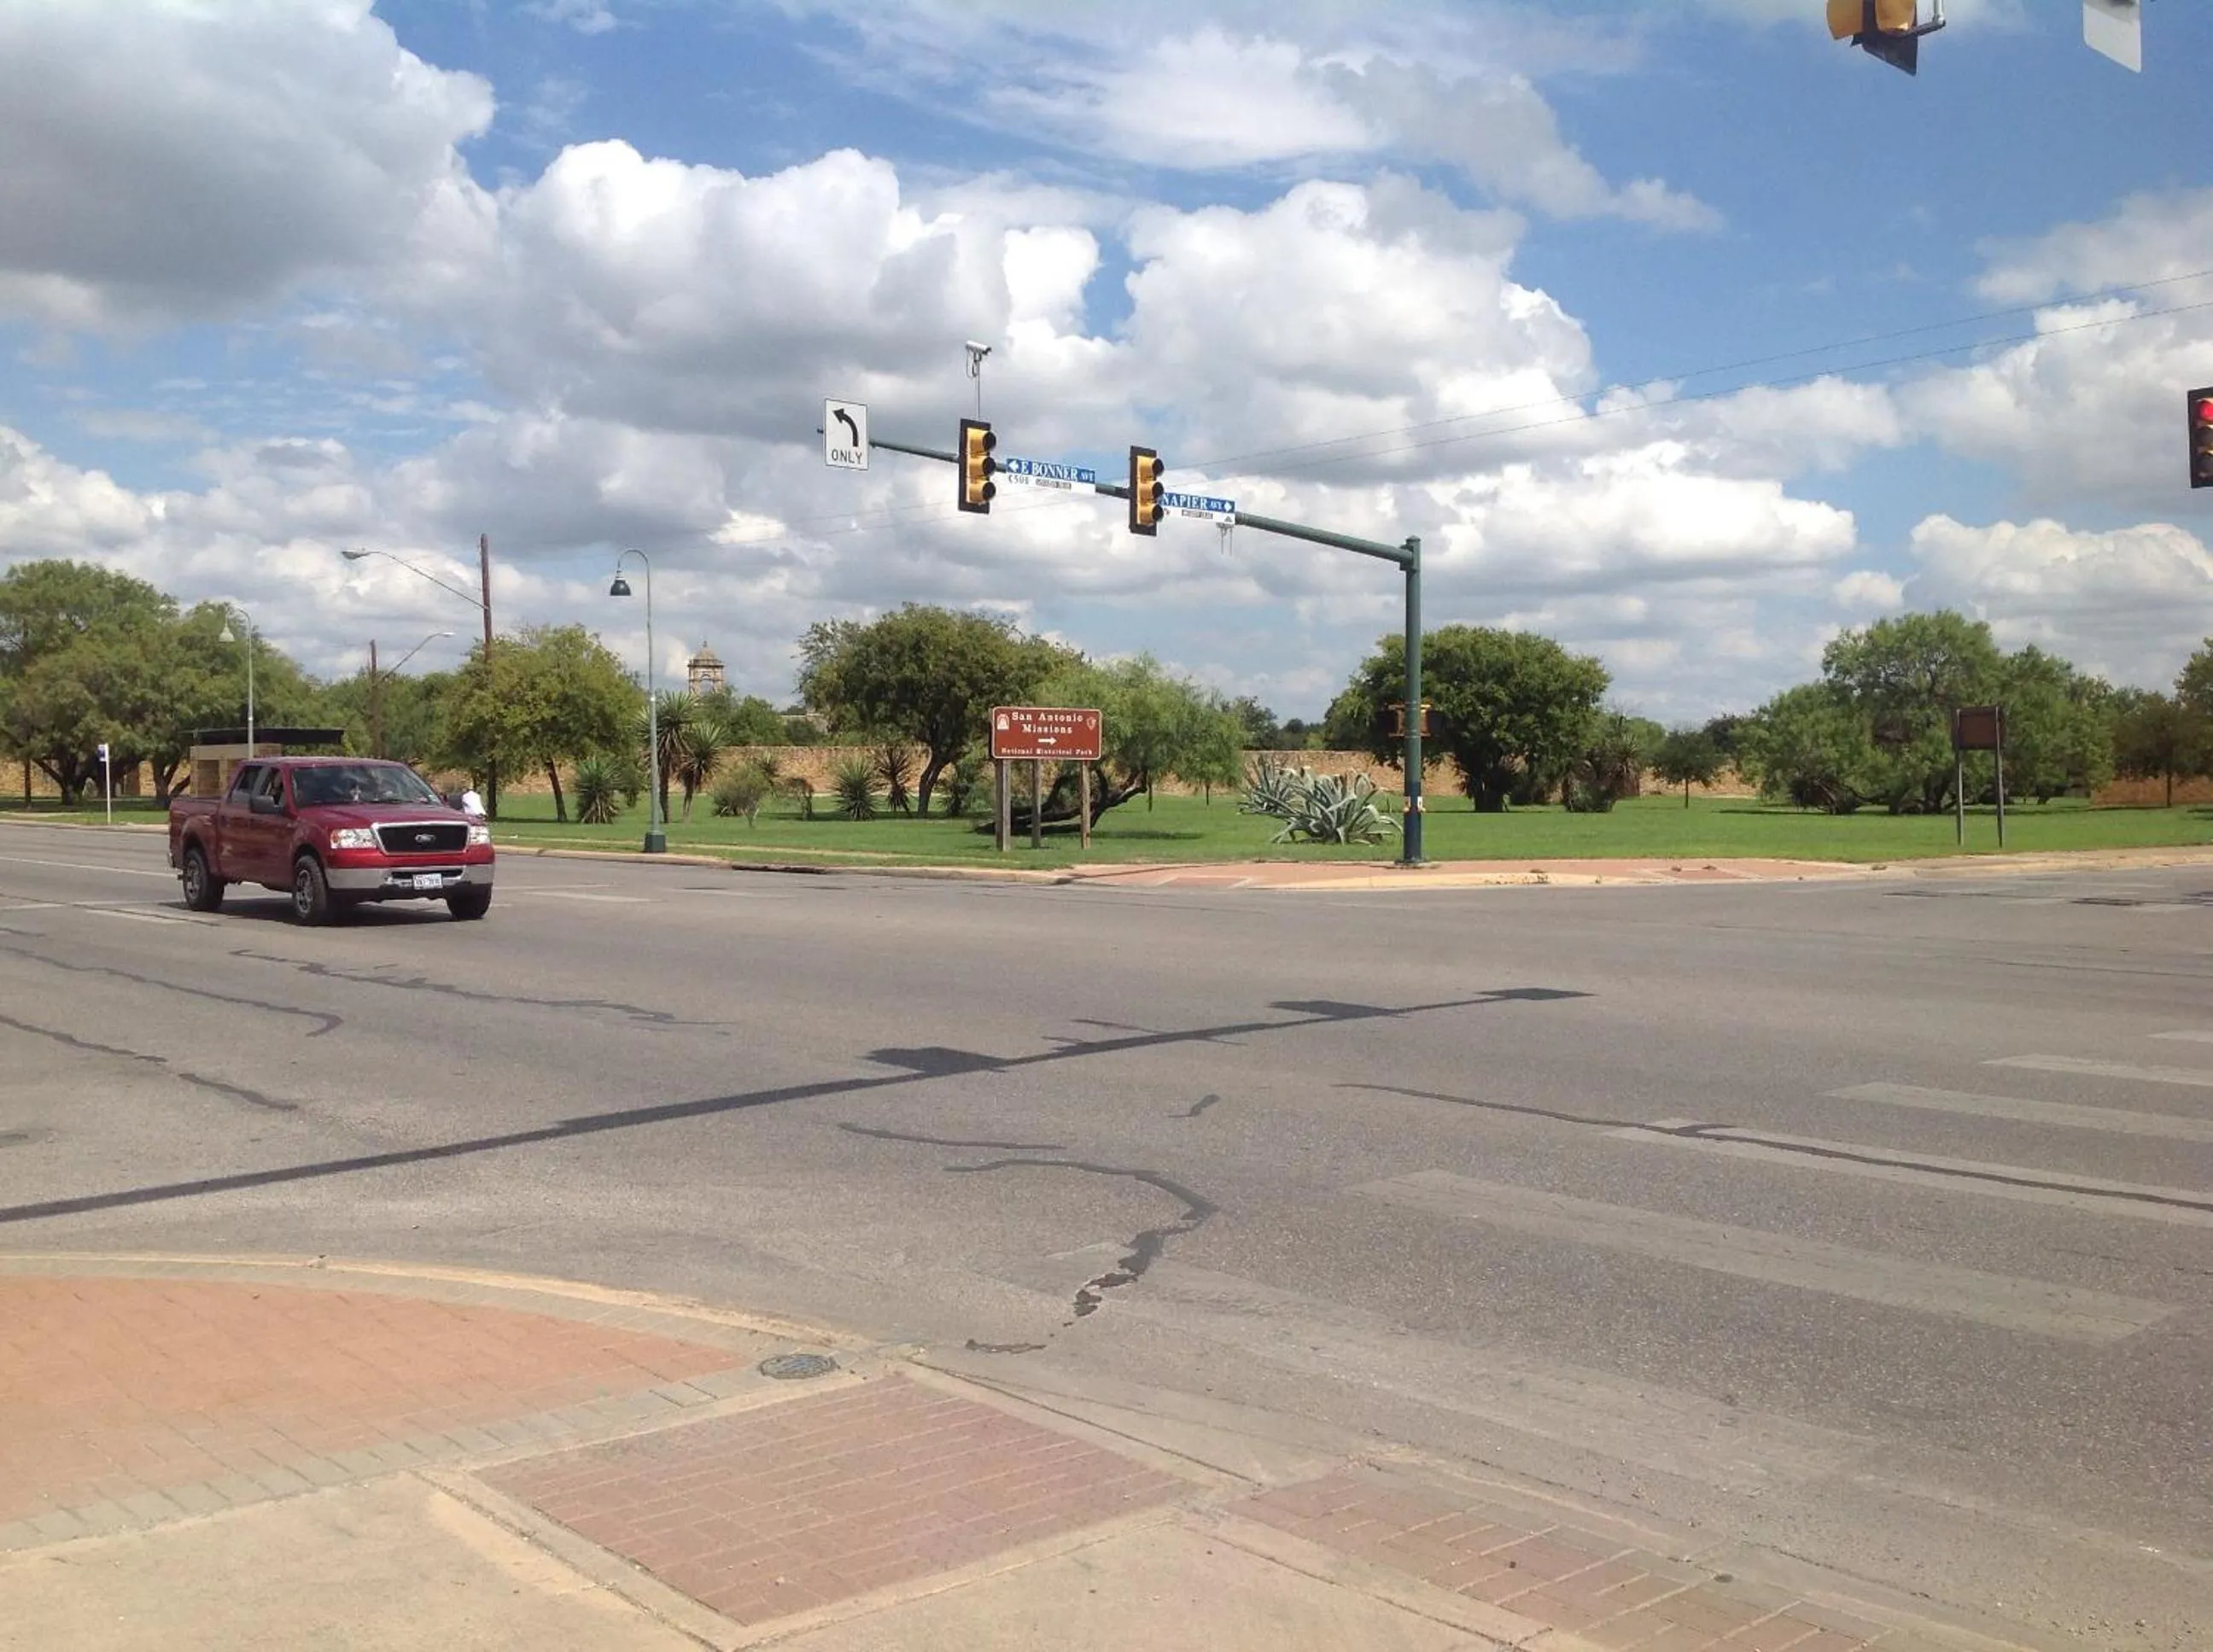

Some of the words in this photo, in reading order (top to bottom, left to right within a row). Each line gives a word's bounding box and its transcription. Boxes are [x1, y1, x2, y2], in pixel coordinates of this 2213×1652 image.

[832, 449, 862, 464] ONLY
[1021, 460, 1029, 475] E
[1032, 461, 1077, 482] BONNER
[1162, 493, 1208, 510] NAPIER
[1012, 711, 1032, 721] San
[1038, 712, 1083, 722] Antonio
[1021, 723, 1073, 734] Missions
